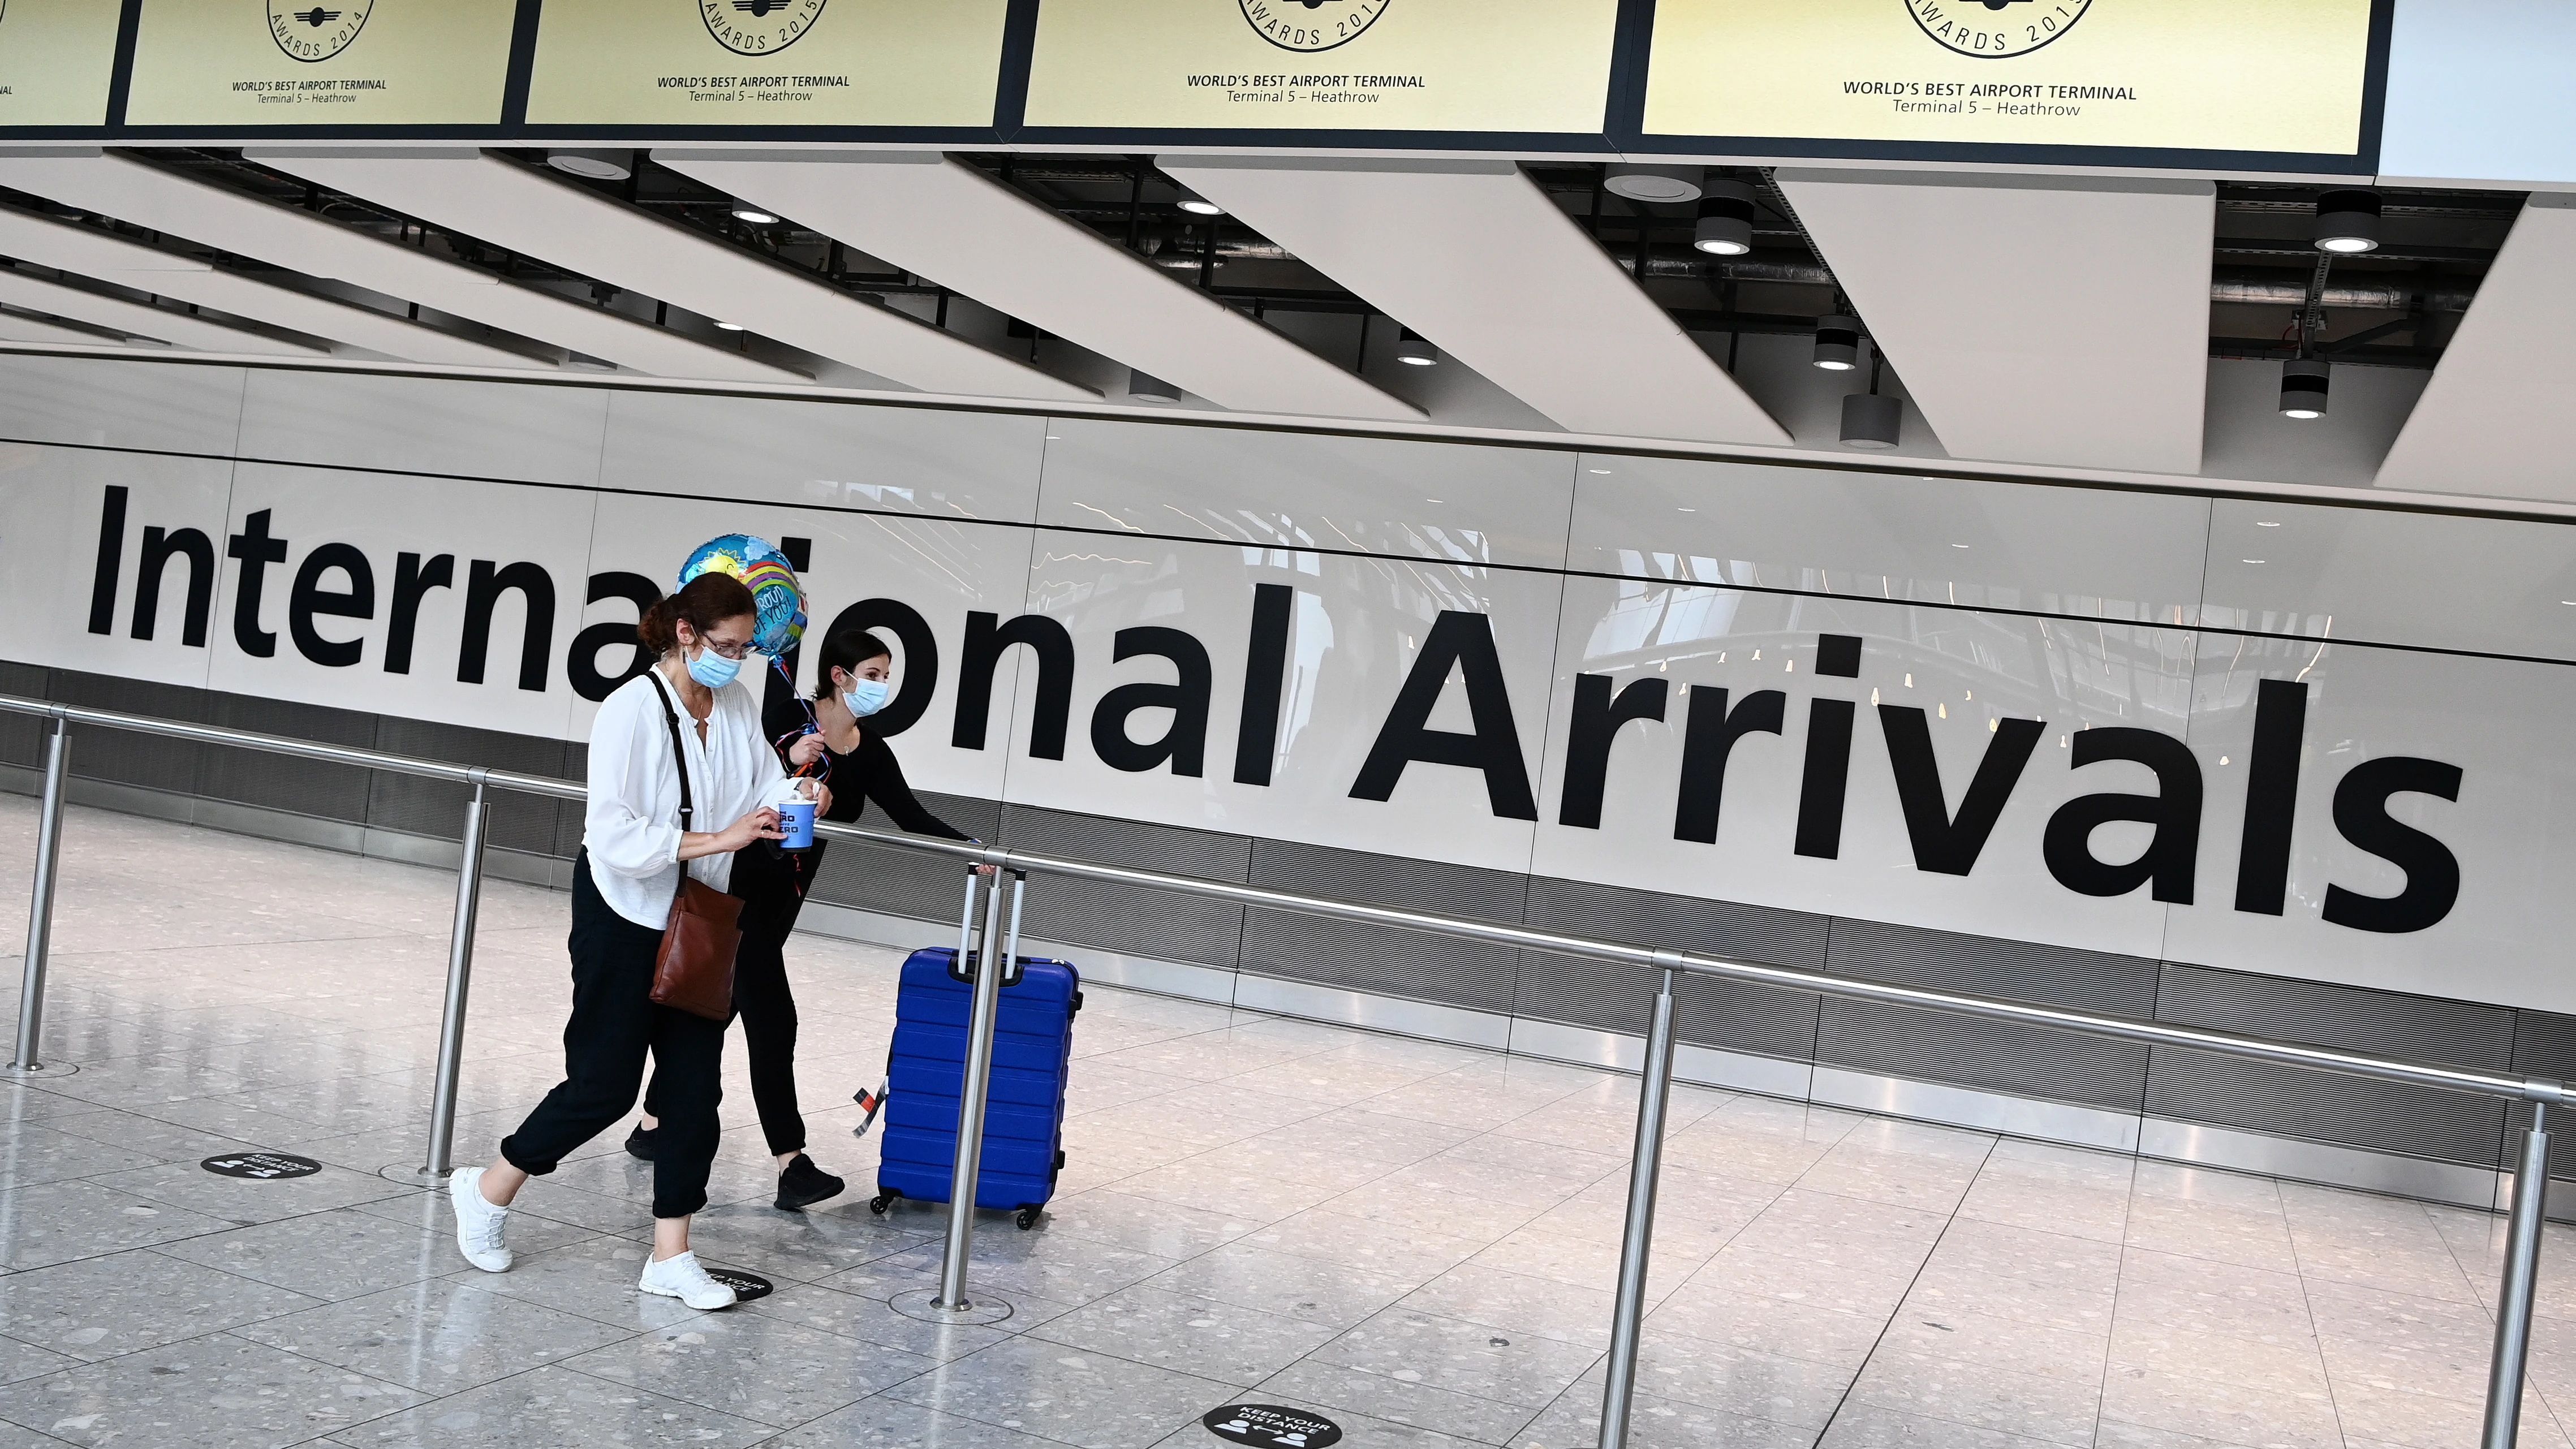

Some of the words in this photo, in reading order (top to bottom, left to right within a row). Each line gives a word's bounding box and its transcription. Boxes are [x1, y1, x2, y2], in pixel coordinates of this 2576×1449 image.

[705, 3, 765, 49] AWARDS
[779, 0, 817, 42] 2015
[1247, 0, 1320, 45] WARDS
[1337, 0, 1382, 37] 201
[1915, 0, 2005, 50] WARDS
[272, 14, 320, 56] AWARDS
[330, 11, 363, 49] 2014
[275, 81, 297, 91] BEST
[298, 80, 338, 90] AIRPORT
[339, 80, 387, 90] TERMINAL
[710, 77, 737, 88] BEST
[740, 76, 789, 87] AIRPORT
[792, 76, 850, 87] TERMINAL
[1253, 75, 1286, 87] BEST
[1289, 75, 1350, 87] AIRPORT
[1354, 76, 1425, 88] TERMINAL
[257, 93, 294, 104] Terminal
[297, 93, 302, 104] 5
[312, 93, 356, 103] Heathrow
[689, 90, 735, 101] Terminal
[738, 90, 745, 101] 5
[757, 90, 813, 101] Heathrow
[1227, 90, 1283, 102] Terminal
[1287, 90, 1295, 102] 5
[1311, 90, 1379, 103] Heathrow
[1925, 83, 1965, 97] BEST
[1970, 84, 2044, 98] AIRPORT
[2049, 86, 2137, 100] TERMINAL
[1893, 99, 1962, 113] Terminal
[1968, 101, 1977, 114] 5
[1997, 102, 2080, 116] Heathrow
[755, 585, 784, 610] ROUD
[765, 596, 792, 624] YOU!
[88, 485, 1293, 787] Internaional
[1348, 610, 2463, 933] Arrivals
[242, 1157, 299, 1171] DISTANCE
[281, 1161, 314, 1171] YOUR
[726, 1277, 765, 1290] YOUR
[1238, 1412, 1319, 1435] DISTANCE
[1240, 1406, 1281, 1418] KEEP
[1285, 1416, 1330, 1431] YOUR
